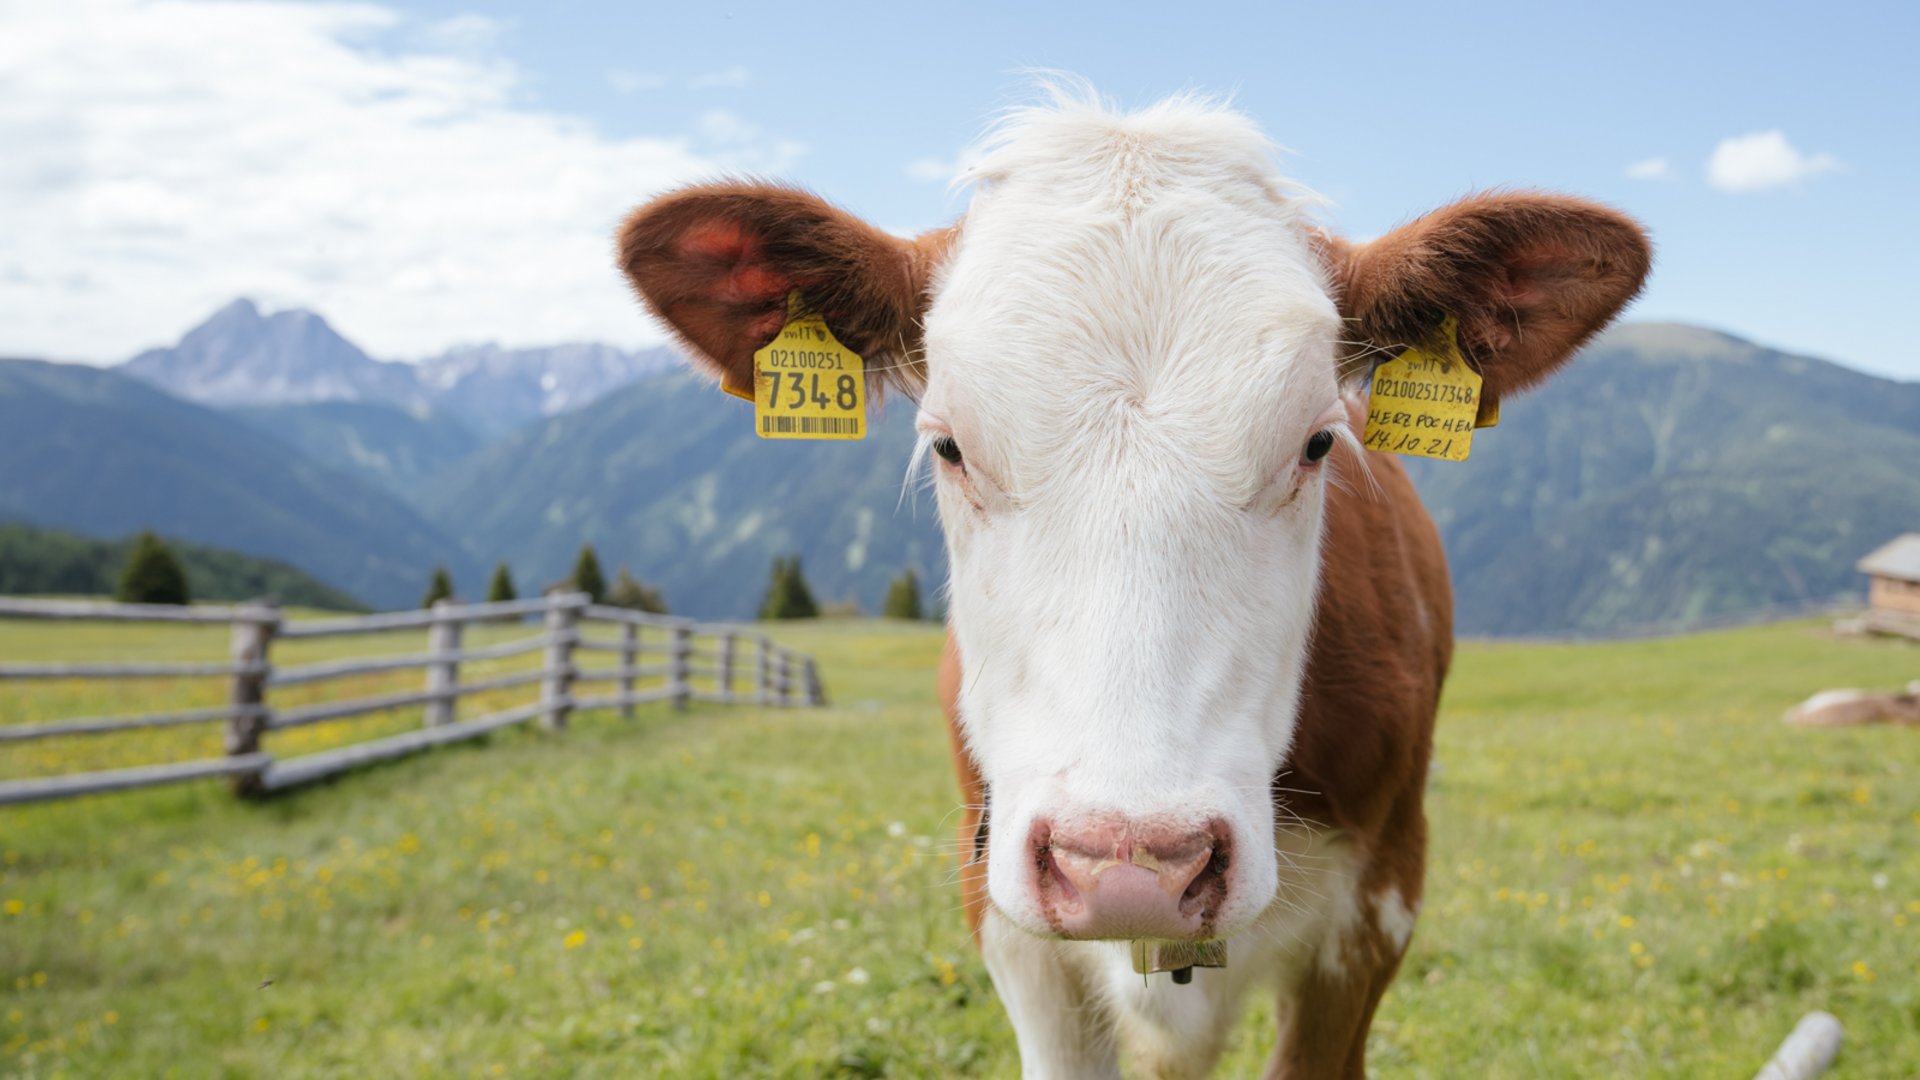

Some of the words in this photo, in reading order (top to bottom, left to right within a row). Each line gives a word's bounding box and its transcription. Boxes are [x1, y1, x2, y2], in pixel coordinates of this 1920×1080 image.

[771, 349, 844, 370] 02100251
[761, 371, 858, 411] 7348
[1375, 378, 1473, 404] 021002517348
